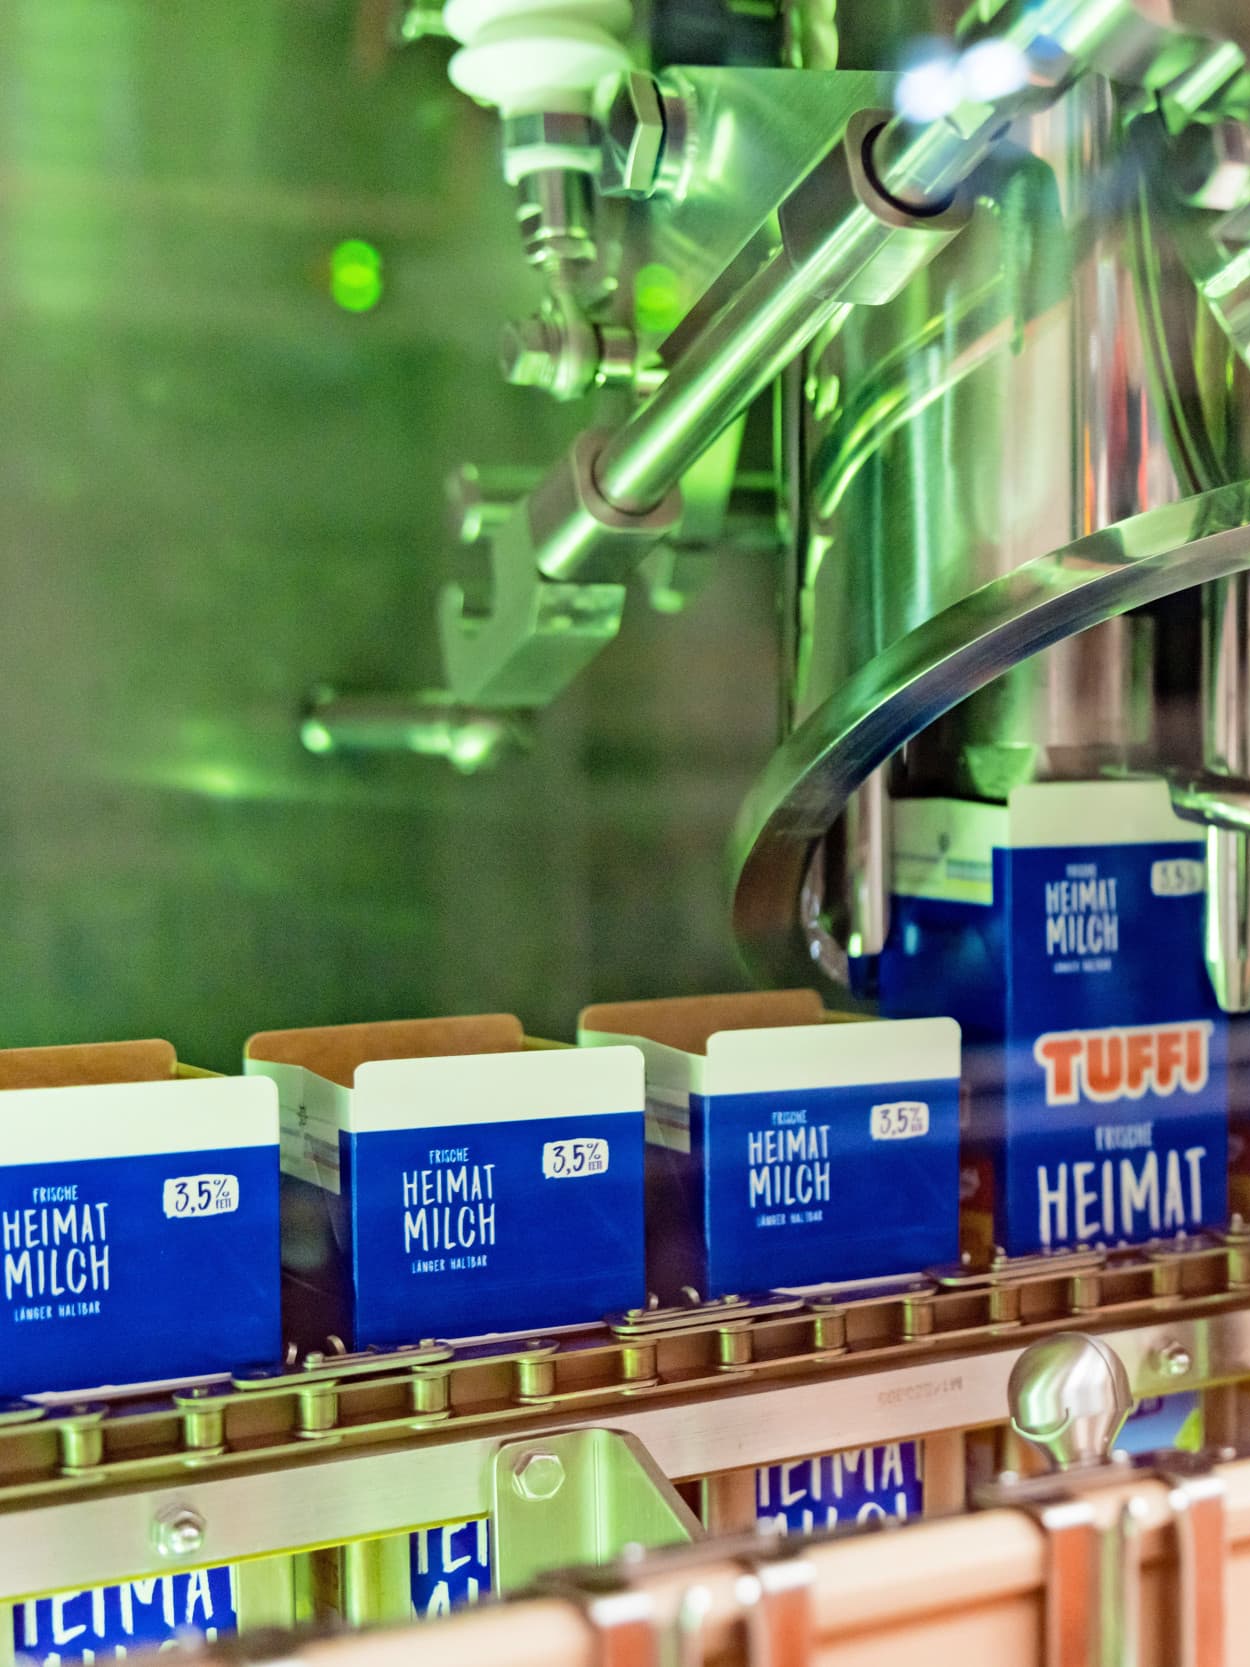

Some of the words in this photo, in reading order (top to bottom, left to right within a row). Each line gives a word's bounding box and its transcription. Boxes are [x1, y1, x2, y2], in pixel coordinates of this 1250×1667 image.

[1045, 877, 1118, 915] HEIMAT
[1045, 914, 1119, 956] MILCH
[1034, 1019, 1214, 1107] TUFFI
[429, 1147, 469, 1165] FRISCHE
[552, 1142, 602, 1175] 3,5%
[748, 1125, 830, 1166] HEIMAT
[33, 1185, 79, 1204] FRISCHE
[175, 1178, 231, 1214] 3,5%
[402, 1163, 496, 1208] HEIMAT
[749, 1161, 830, 1208] MILCH
[1037, 1146, 1206, 1246] HEIMAT
[2, 1202, 109, 1250] HEIMAT
[404, 1202, 497, 1254] MILCH
[4, 1244, 110, 1300] MILCH
